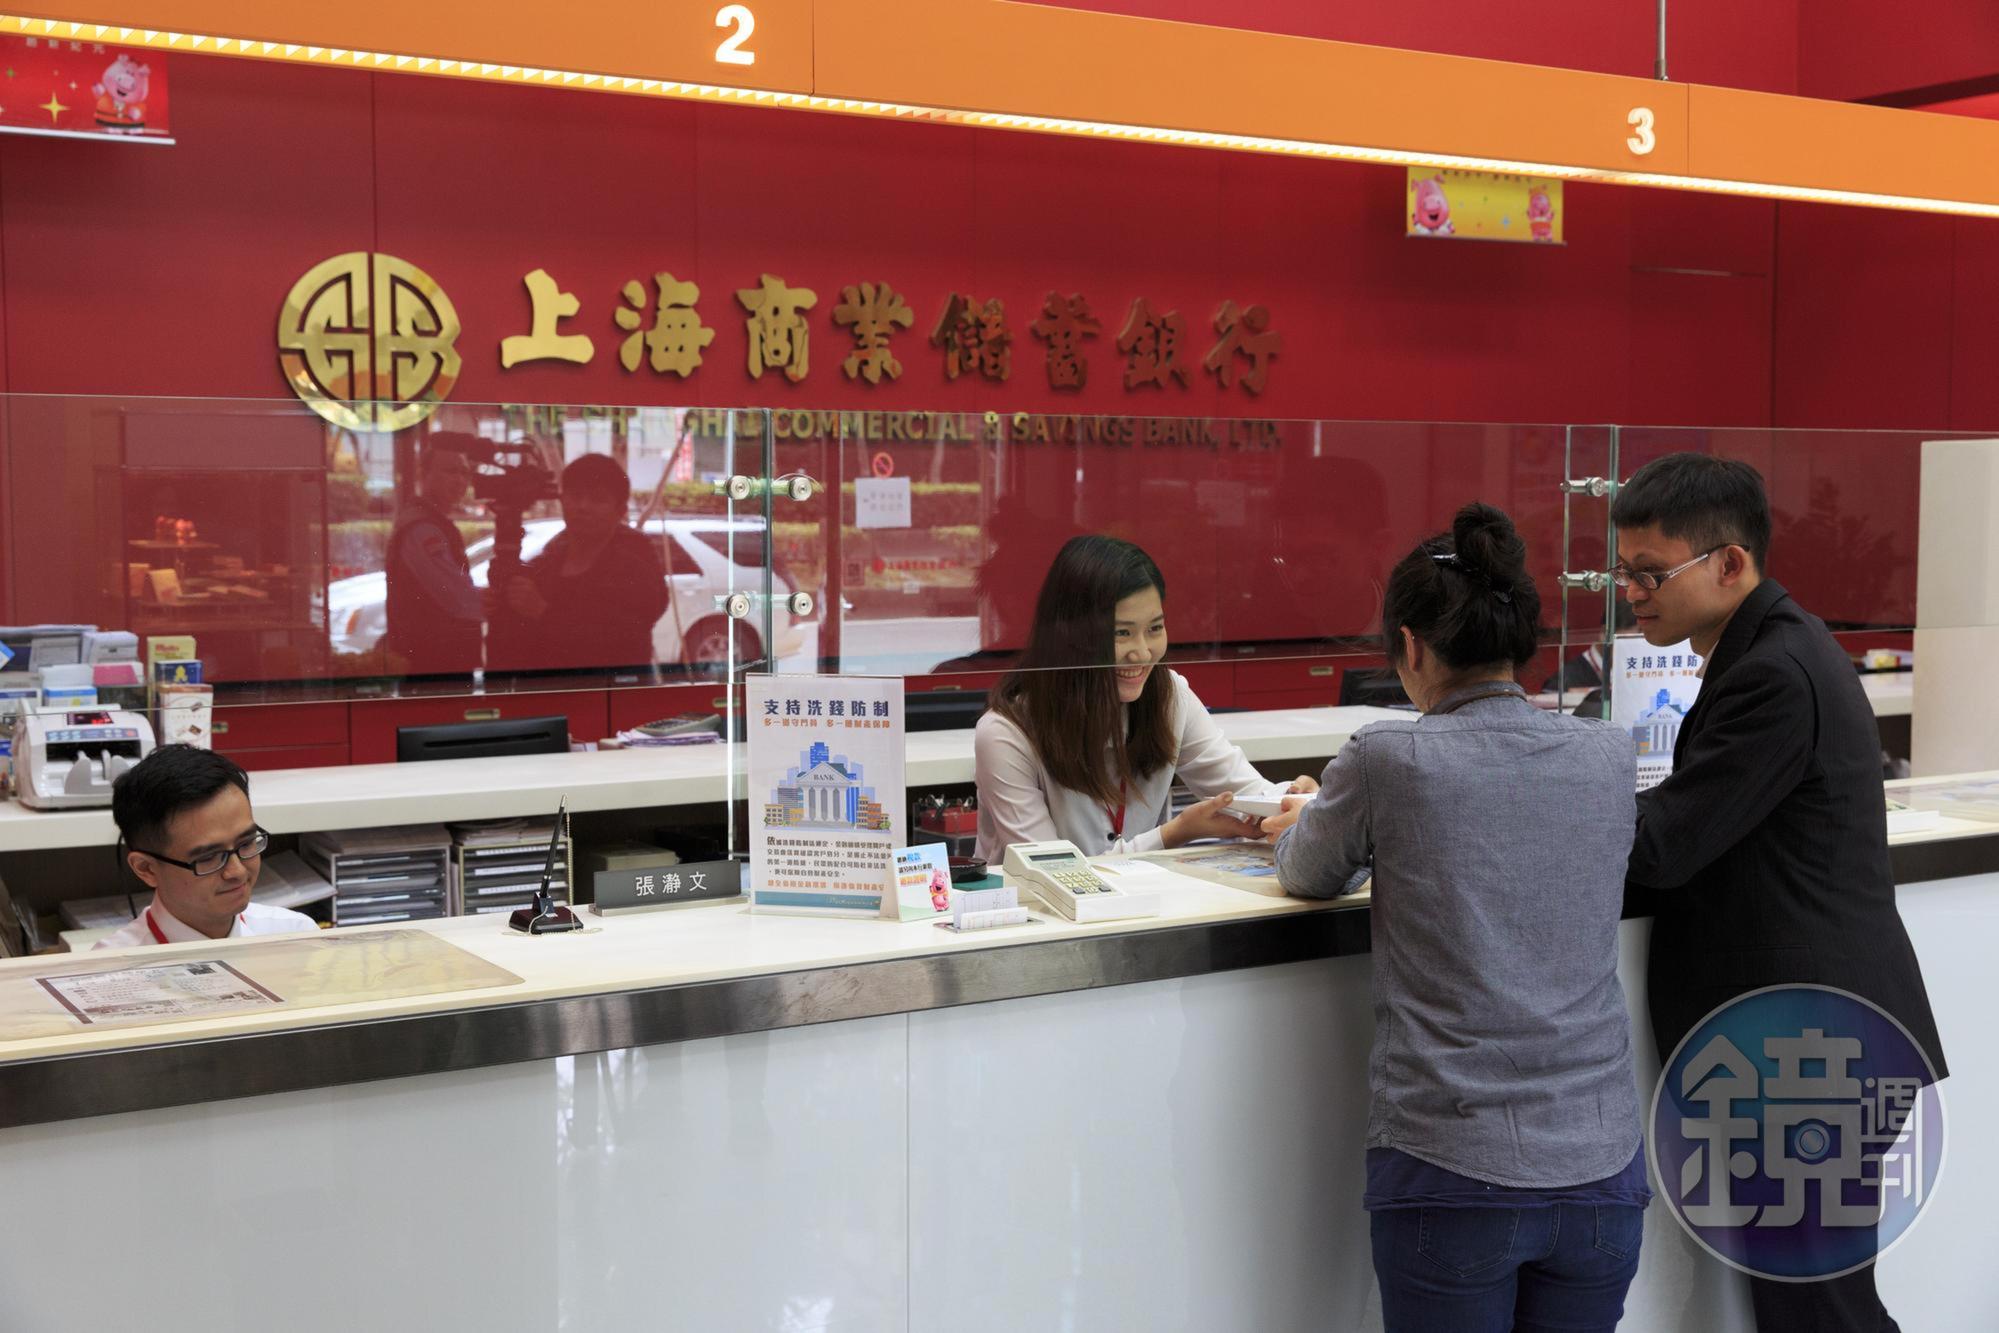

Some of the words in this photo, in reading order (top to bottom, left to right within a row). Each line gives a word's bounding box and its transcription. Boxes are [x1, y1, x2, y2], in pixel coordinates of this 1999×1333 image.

[715, 4, 755, 66] 2
[1627, 107, 1656, 155] 3
[501, 268, 1283, 396] 上海商業儲蓄銀行
[775, 408, 975, 440] COMMERCIAL
[1012, 412, 1135, 443] SAVINGS
[763, 699, 890, 717] 支持洗錢防制
[813, 773, 835, 781] BANK
[635, 870, 707, 897] 張瀞文
